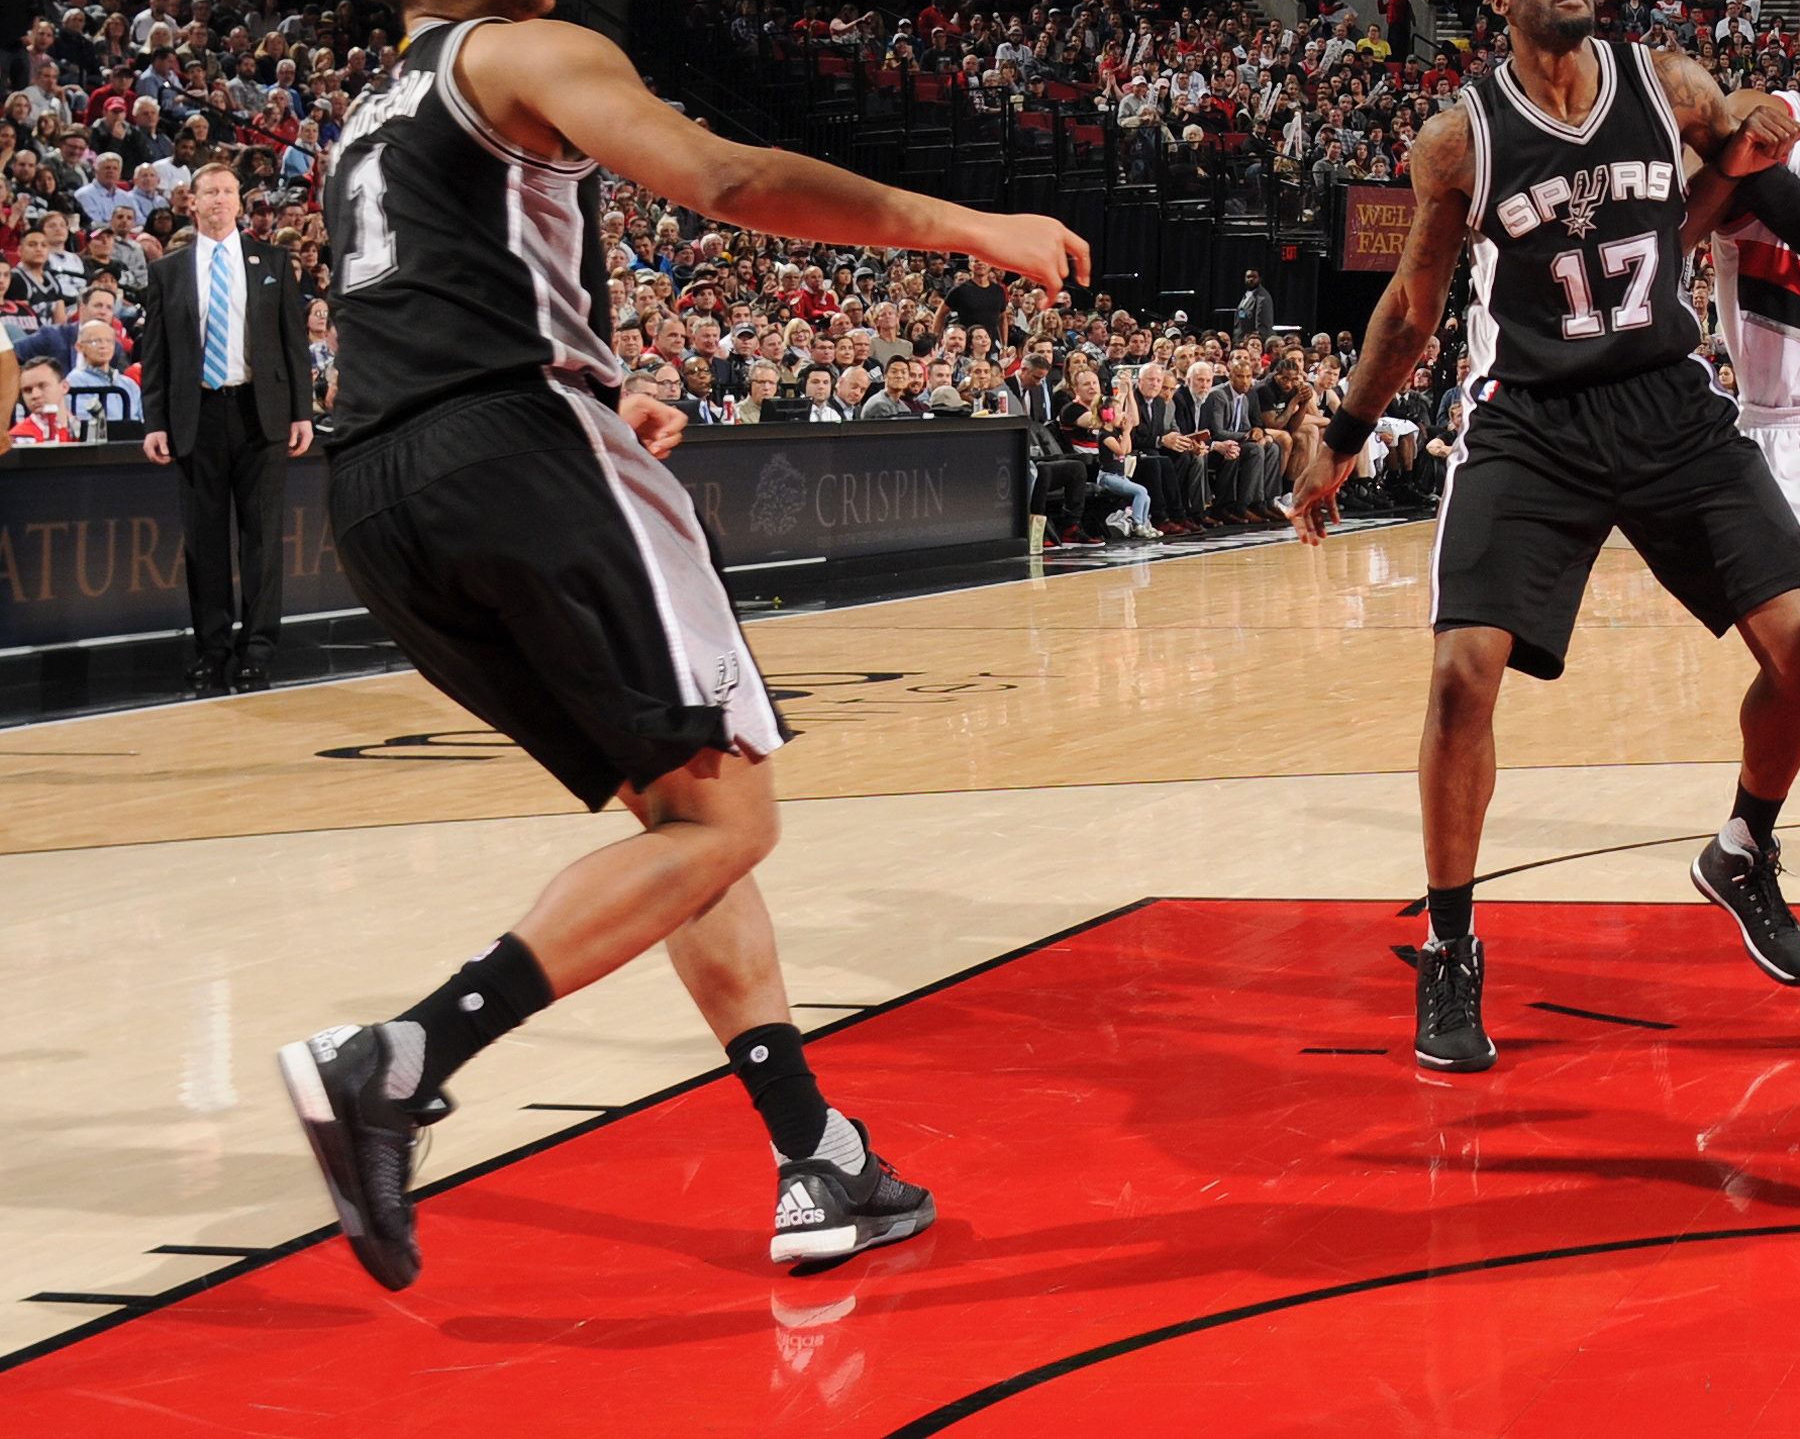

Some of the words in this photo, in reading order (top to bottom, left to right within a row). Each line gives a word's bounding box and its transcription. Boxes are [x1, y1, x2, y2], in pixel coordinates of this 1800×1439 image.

[341, 142, 399, 295] 1
[1356, 204, 1419, 227] WEL
[1497, 161, 1674, 238] SPURS
[1357, 232, 1405, 253] FAR
[1550, 231, 1659, 340] 17
[816, 468, 945, 528] CRISPIN
[775, 1208, 825, 1229] adidas
